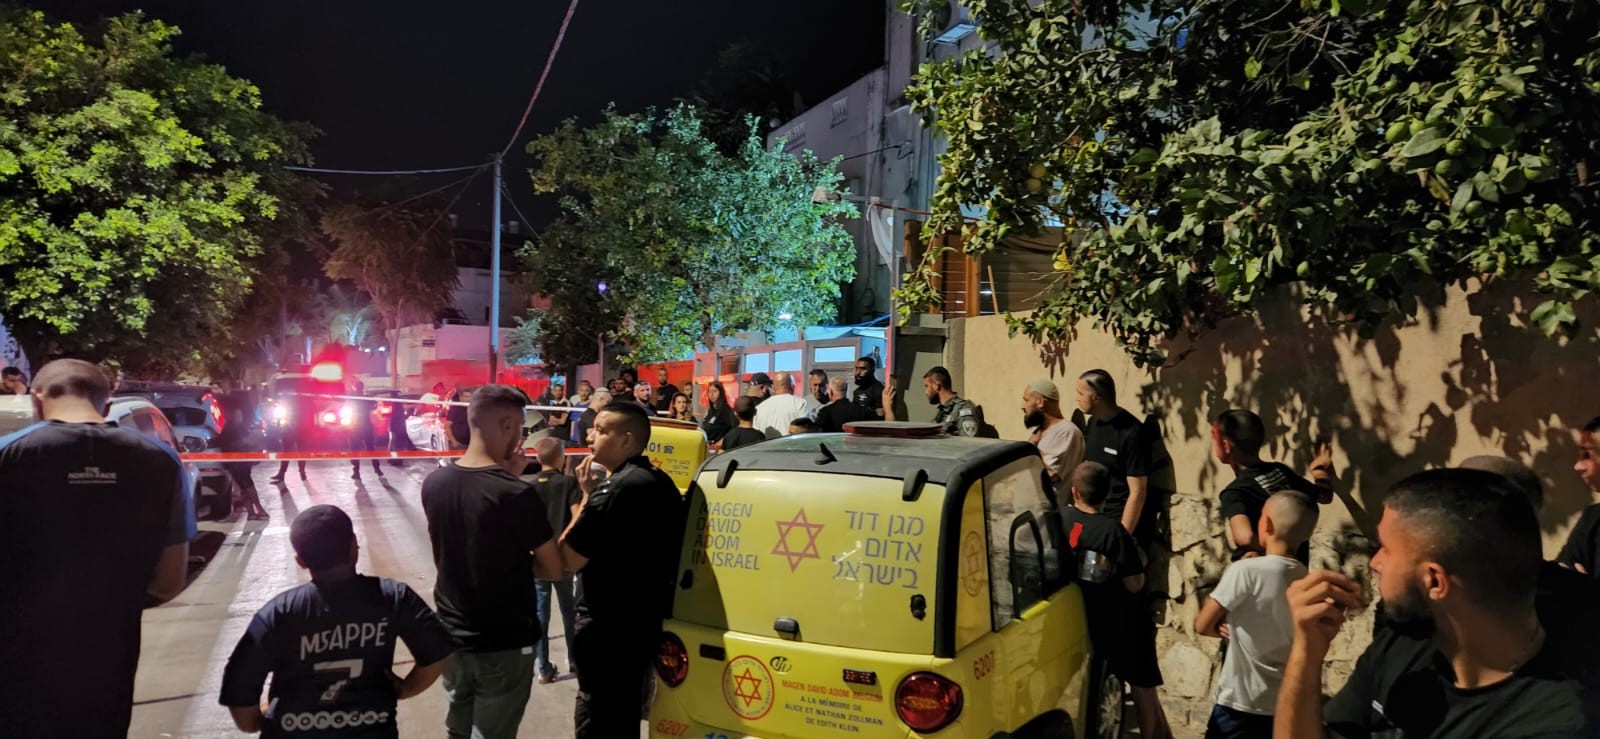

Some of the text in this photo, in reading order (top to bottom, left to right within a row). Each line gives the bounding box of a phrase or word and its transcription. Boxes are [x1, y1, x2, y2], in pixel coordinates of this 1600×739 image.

[645, 442, 661, 453] 01
[699, 501, 753, 518] MAGEN
[696, 517, 742, 534] DAVID
[844, 510, 925, 537] מגן דוד
[693, 534, 740, 551] ADOM
[865, 538, 922, 563] אדום
[692, 549, 761, 571] IN ISRAEL
[832, 554, 919, 589] בישראל
[973, 650, 995, 680] 6207
[313, 659, 364, 702] 7
[782, 679, 805, 690] MAGEN
[807, 683, 827, 694] DAVID
[829, 687, 849, 698] ADOM
[807, 696, 817, 704] LA
[805, 706, 813, 714] ET
[816, 707, 846, 720] NATHAN
[849, 714, 883, 726] ZOLLMAN
[656, 720, 689, 737] 6207
[817, 719, 838, 728] EDITH
[839, 722, 860, 733] KLEIN
